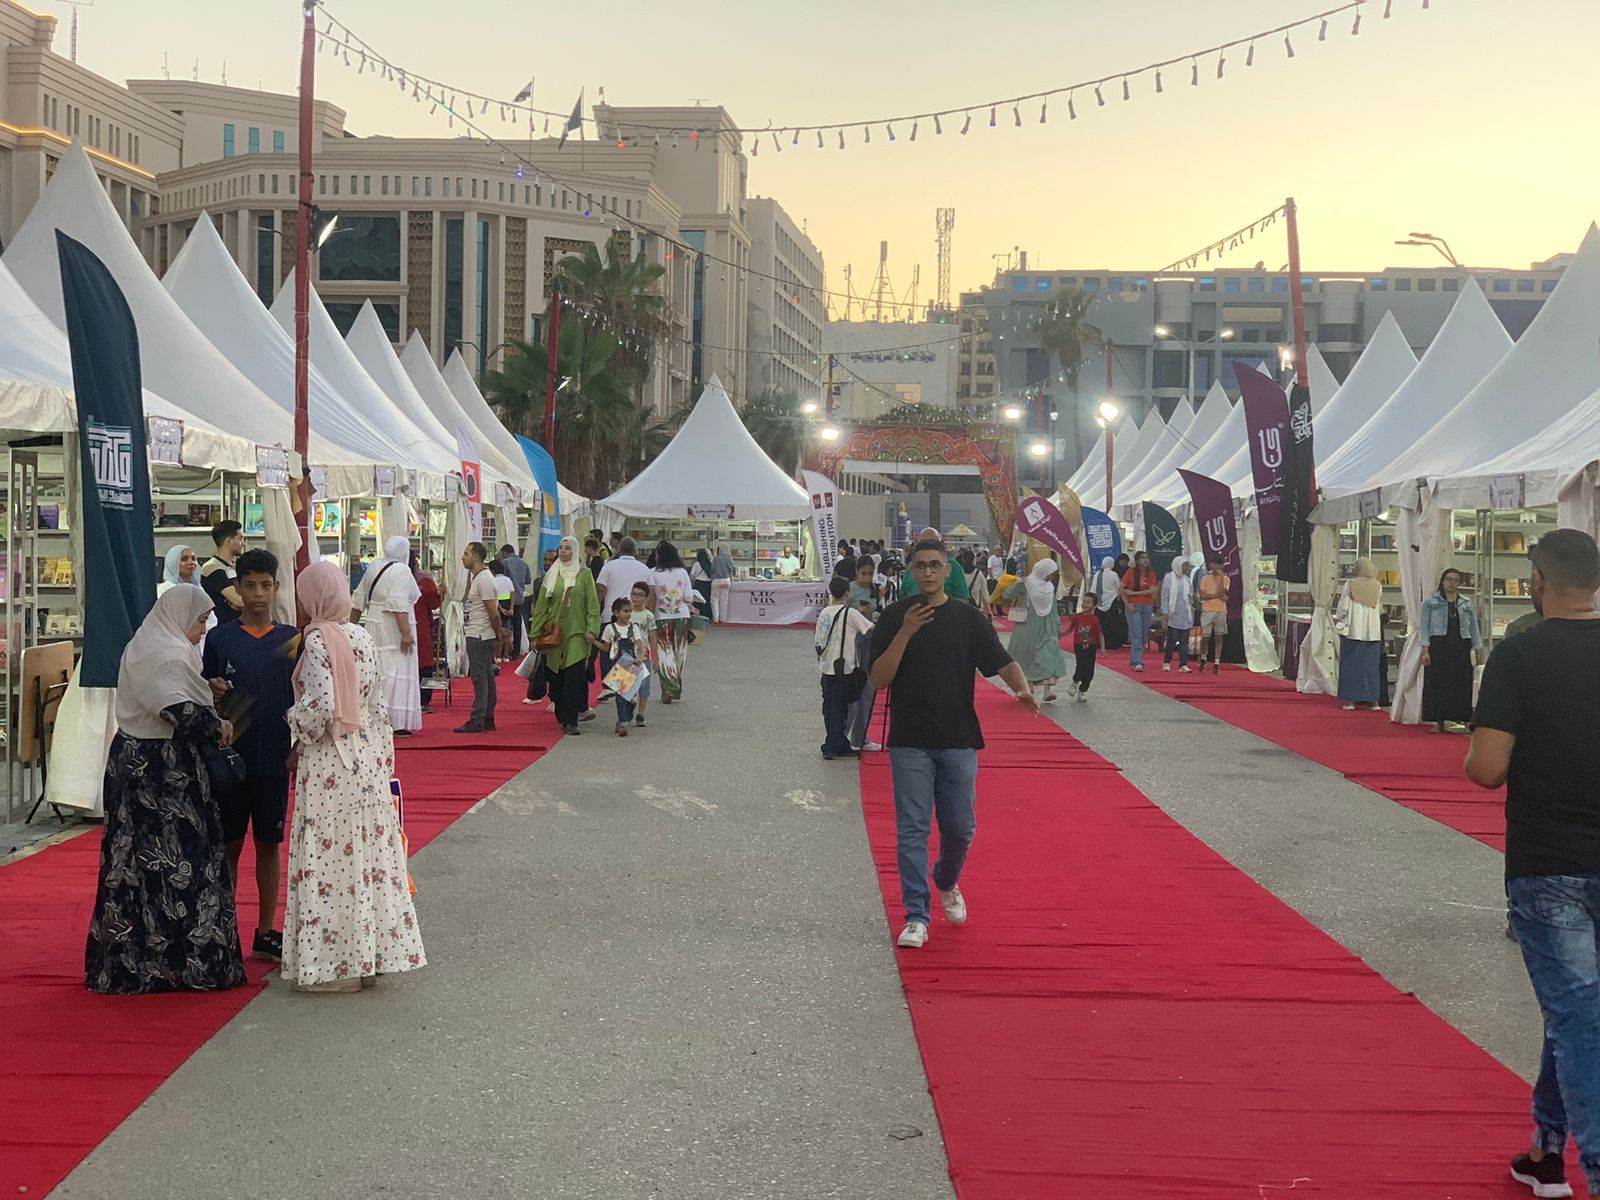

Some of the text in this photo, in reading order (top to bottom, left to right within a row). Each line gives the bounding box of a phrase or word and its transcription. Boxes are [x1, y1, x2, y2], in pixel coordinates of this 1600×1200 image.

[1255, 474, 1285, 495] تاب
[817, 518, 831, 574] PUBLISHING
[749, 591, 776, 604] MK
